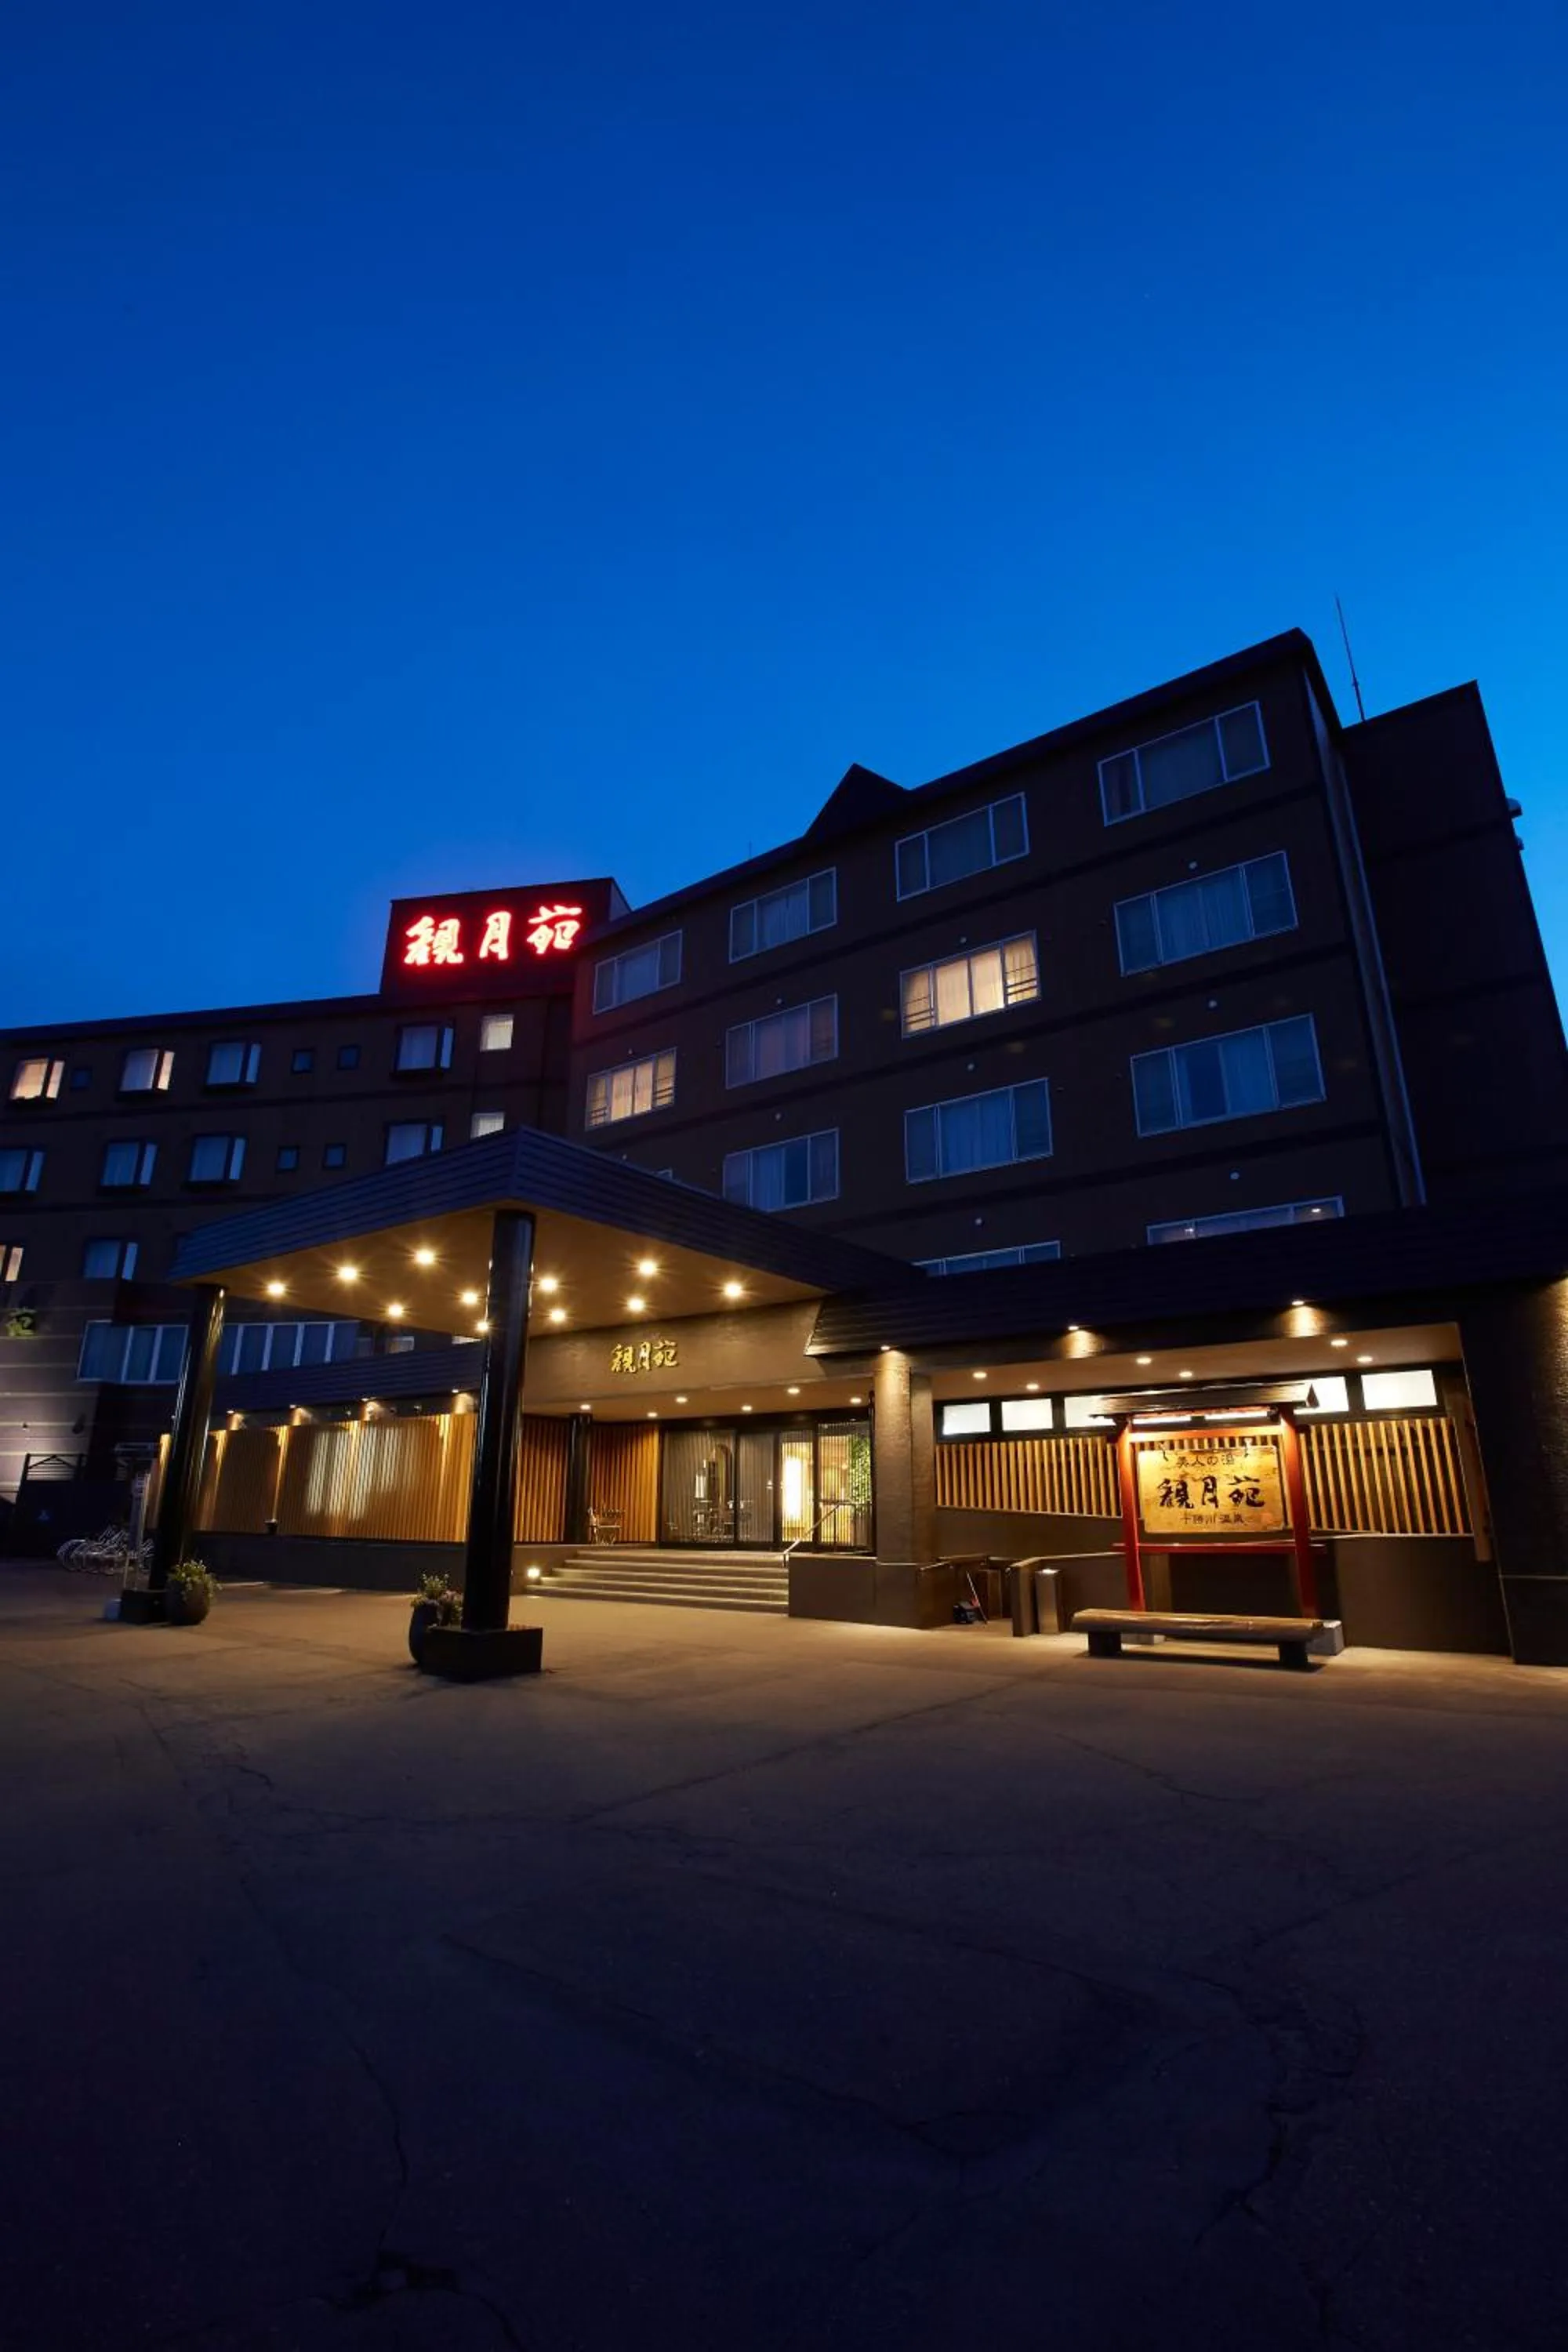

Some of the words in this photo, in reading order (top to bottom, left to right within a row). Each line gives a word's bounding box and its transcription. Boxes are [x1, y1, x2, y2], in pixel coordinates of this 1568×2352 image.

[404, 905, 582, 965] 観月苑
[612, 1340, 679, 1373] 観月苑
[1157, 1475, 1265, 1509] 観月苑
